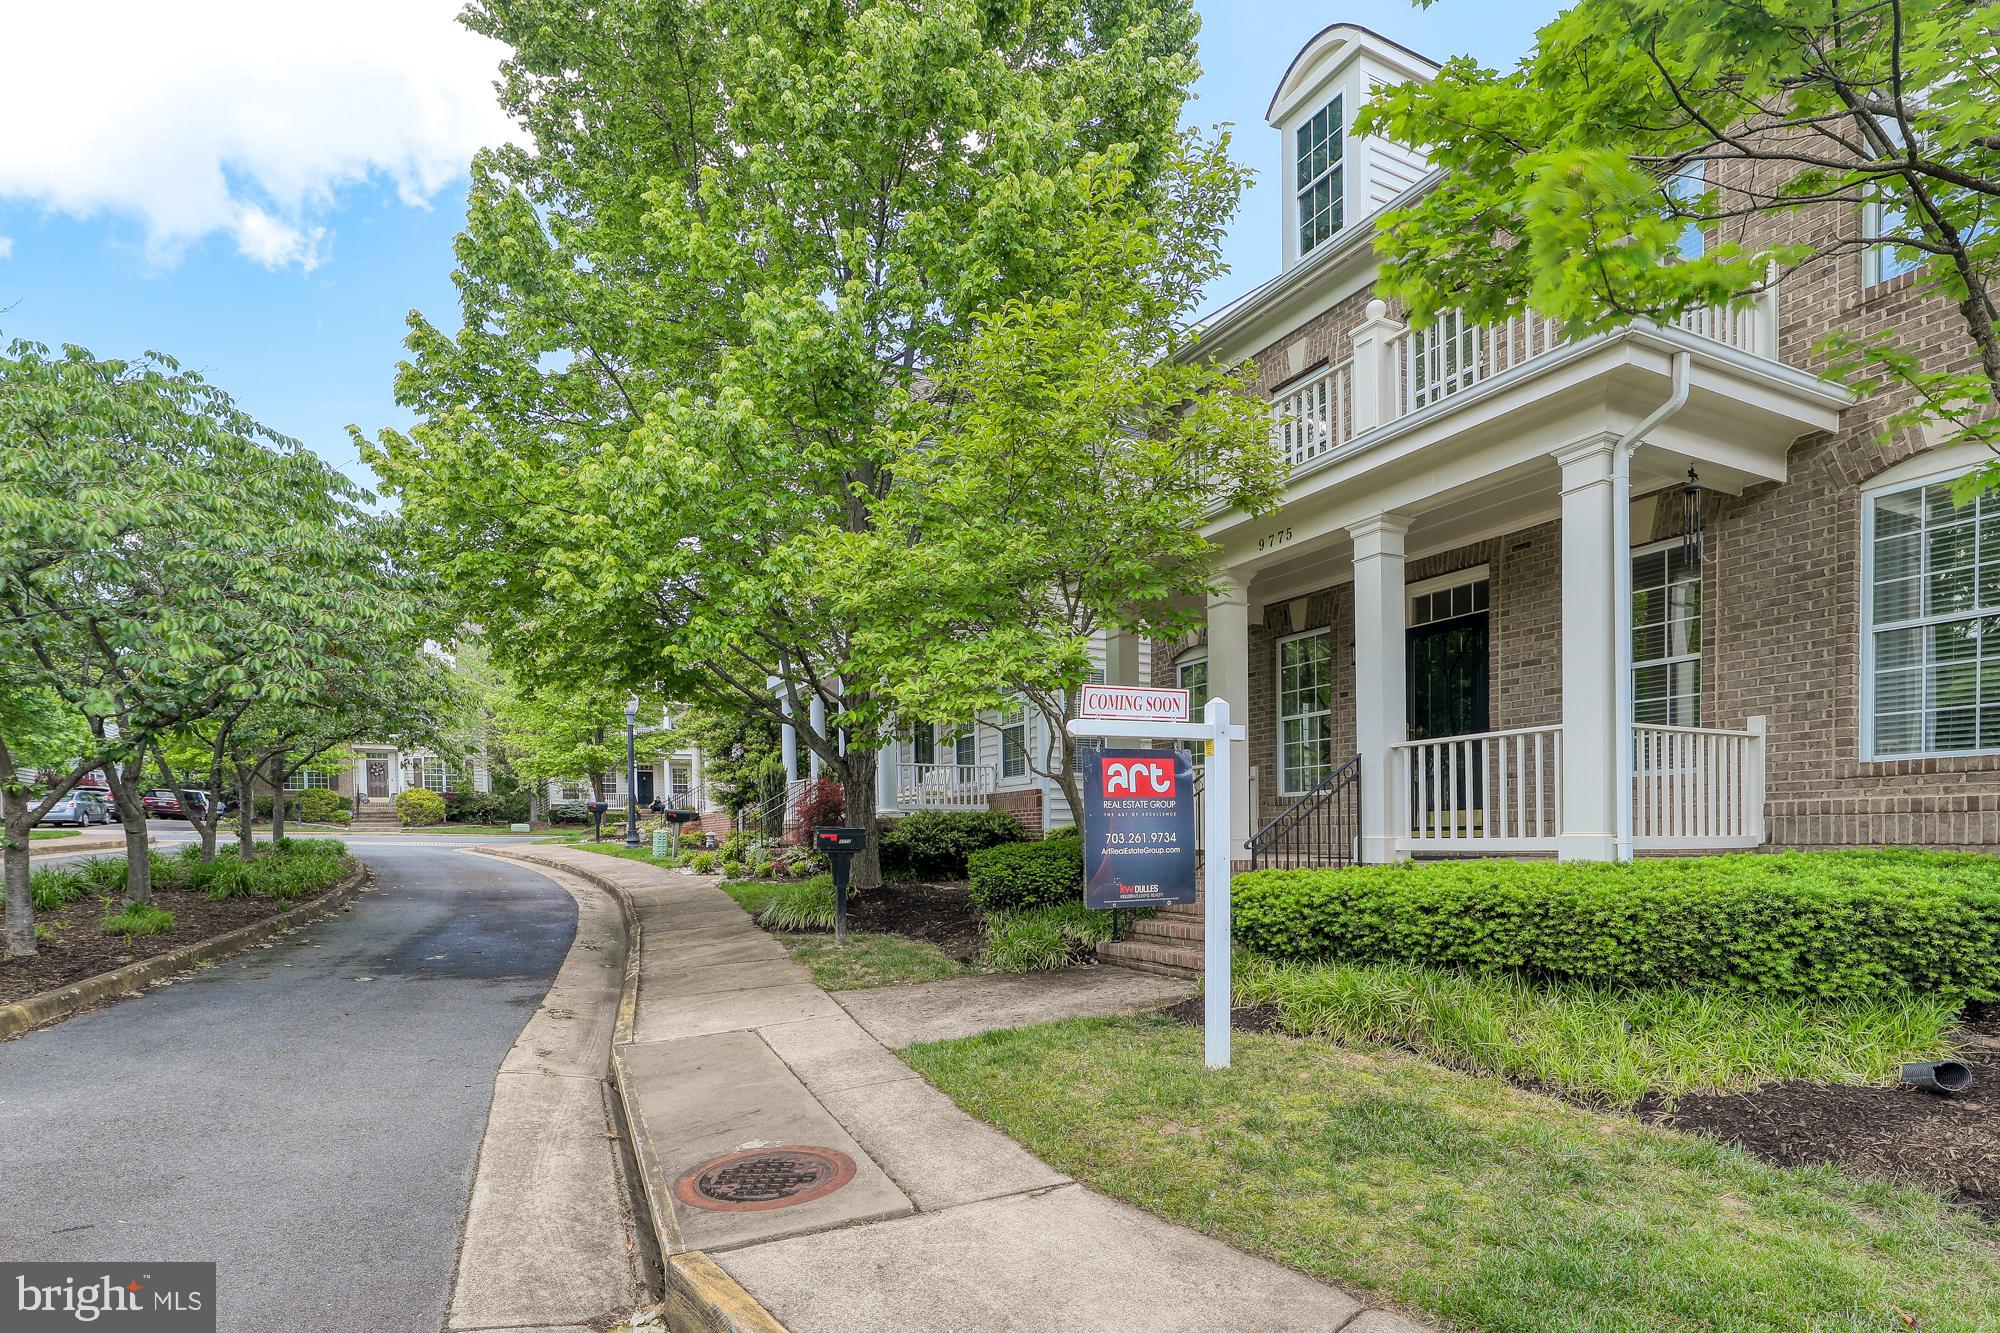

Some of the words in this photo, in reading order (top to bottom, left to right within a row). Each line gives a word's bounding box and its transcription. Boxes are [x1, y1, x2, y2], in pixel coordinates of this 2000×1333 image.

[1258, 527, 1292, 551] 9775
[1089, 693, 1142, 712] COMING
[1146, 696, 1181, 713] SOON
[1103, 800, 1121, 809] REAL
[1122, 800, 1148, 809] ESTATE
[1149, 800, 1176, 809] GROUP
[1105, 832, 1177, 844] 703.261.9734
[1101, 847, 1181, 855] ArtRealEstateGroup.com
[1134, 885, 1159, 893] DULLES
